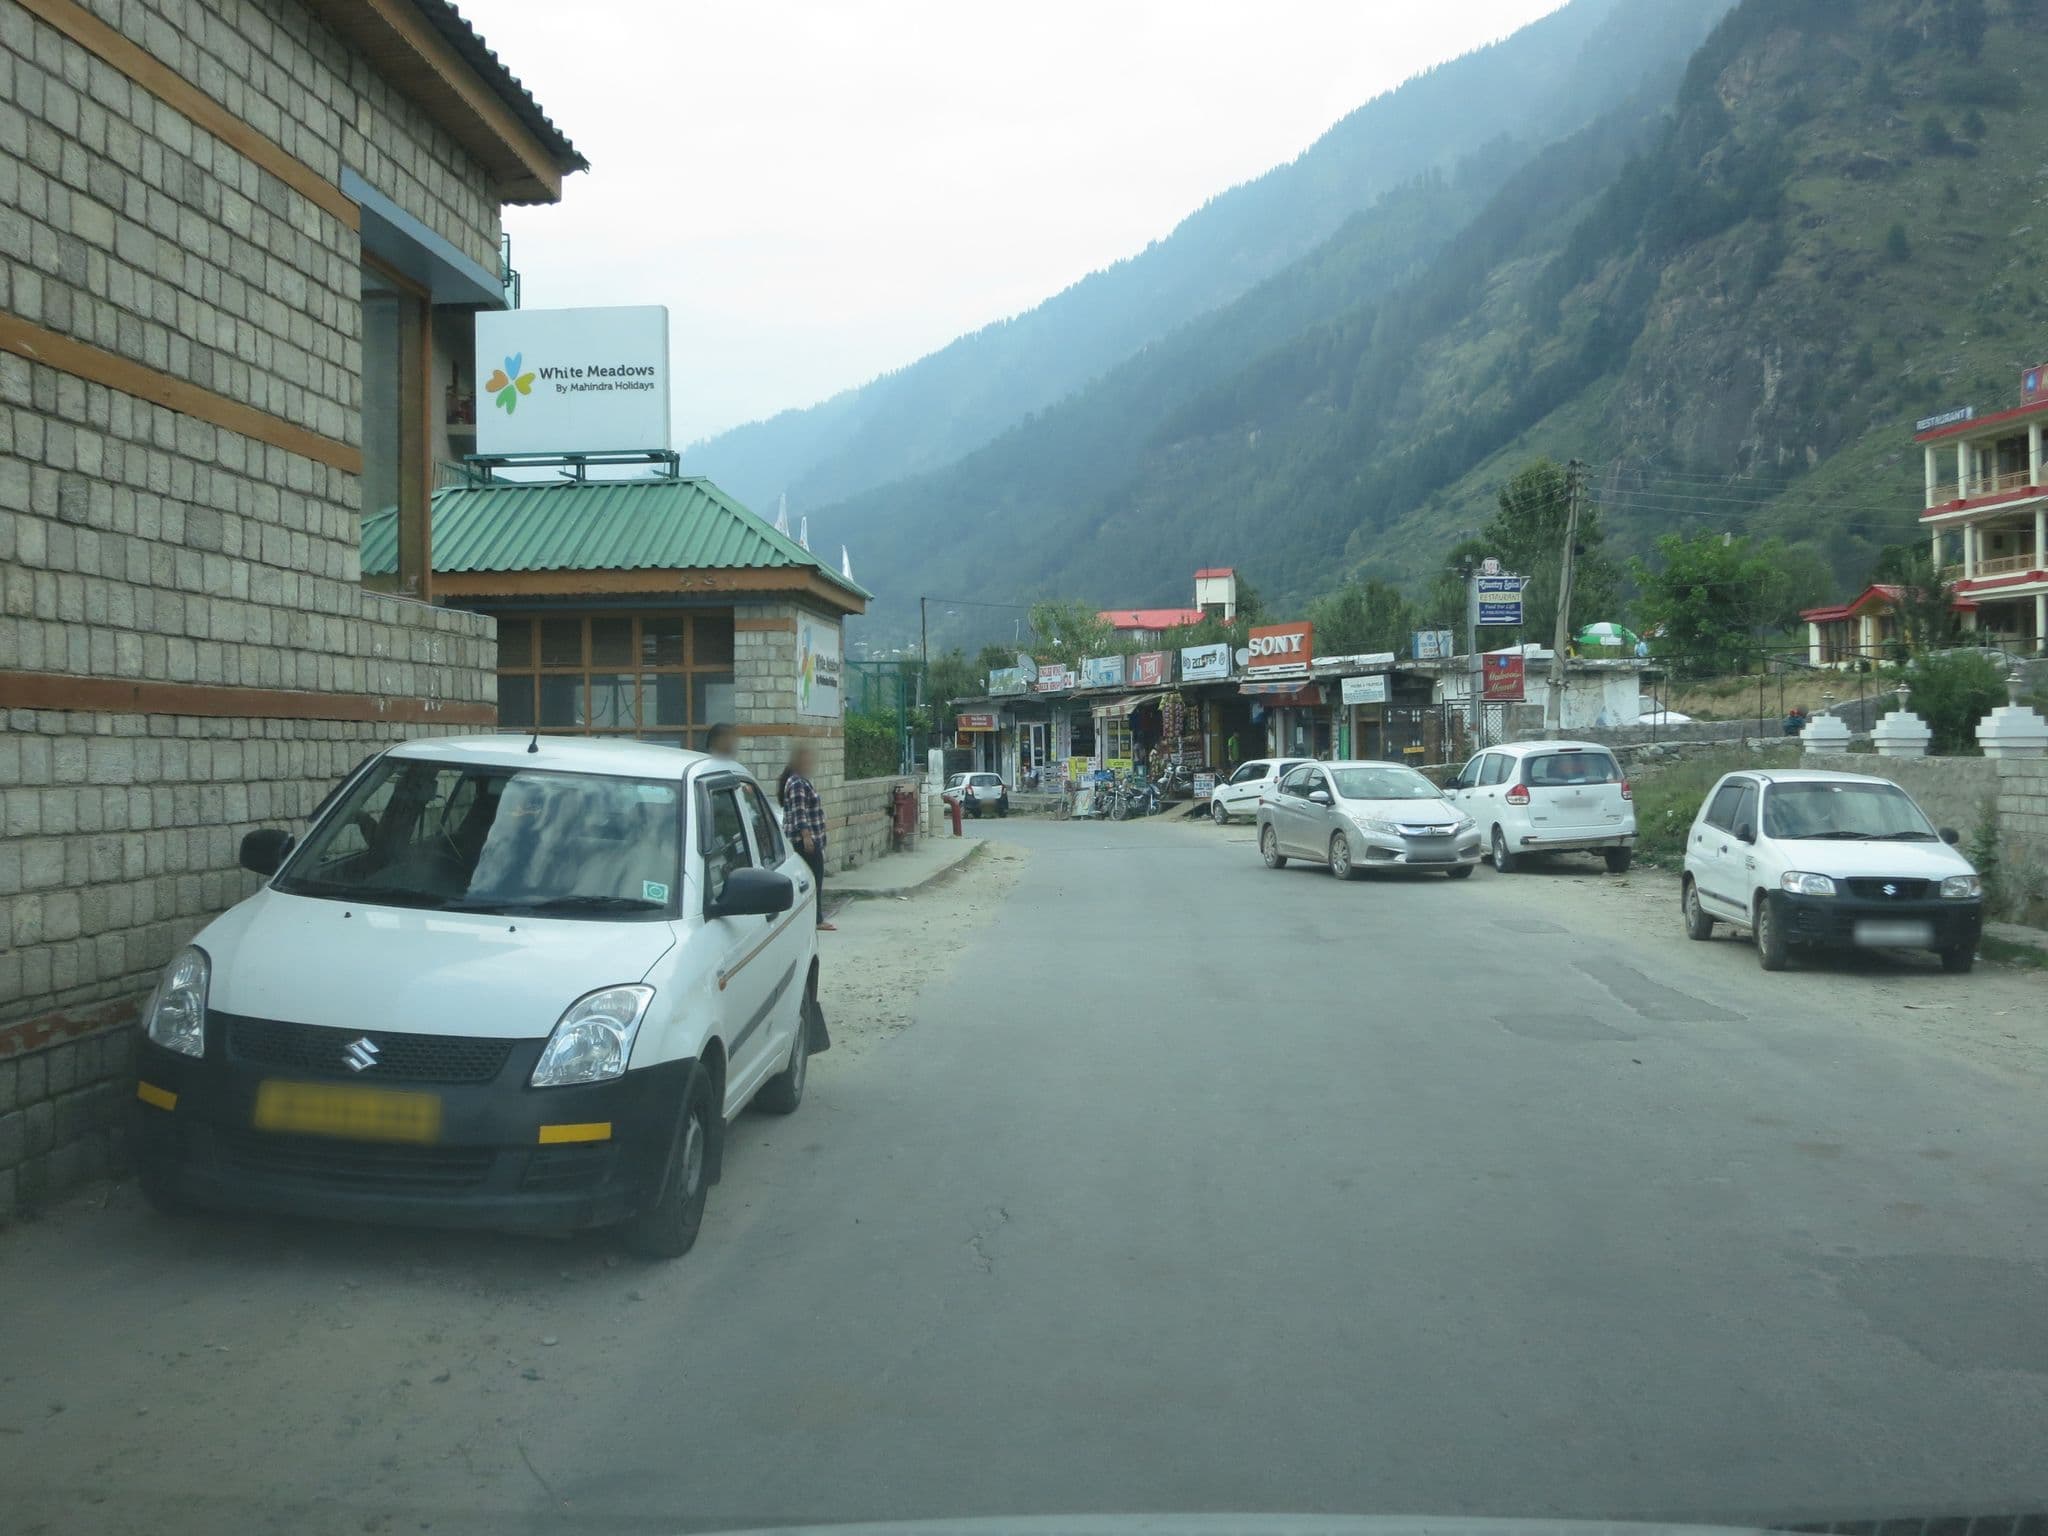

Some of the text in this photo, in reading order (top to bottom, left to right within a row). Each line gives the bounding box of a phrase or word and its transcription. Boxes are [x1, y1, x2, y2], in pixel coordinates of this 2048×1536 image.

[539, 364, 655, 379] White Meadows
[555, 381, 655, 394] By Mahindra Holidays
[1479, 593, 1520, 601] RESTAURANT
[1248, 634, 1304, 656] SONY
